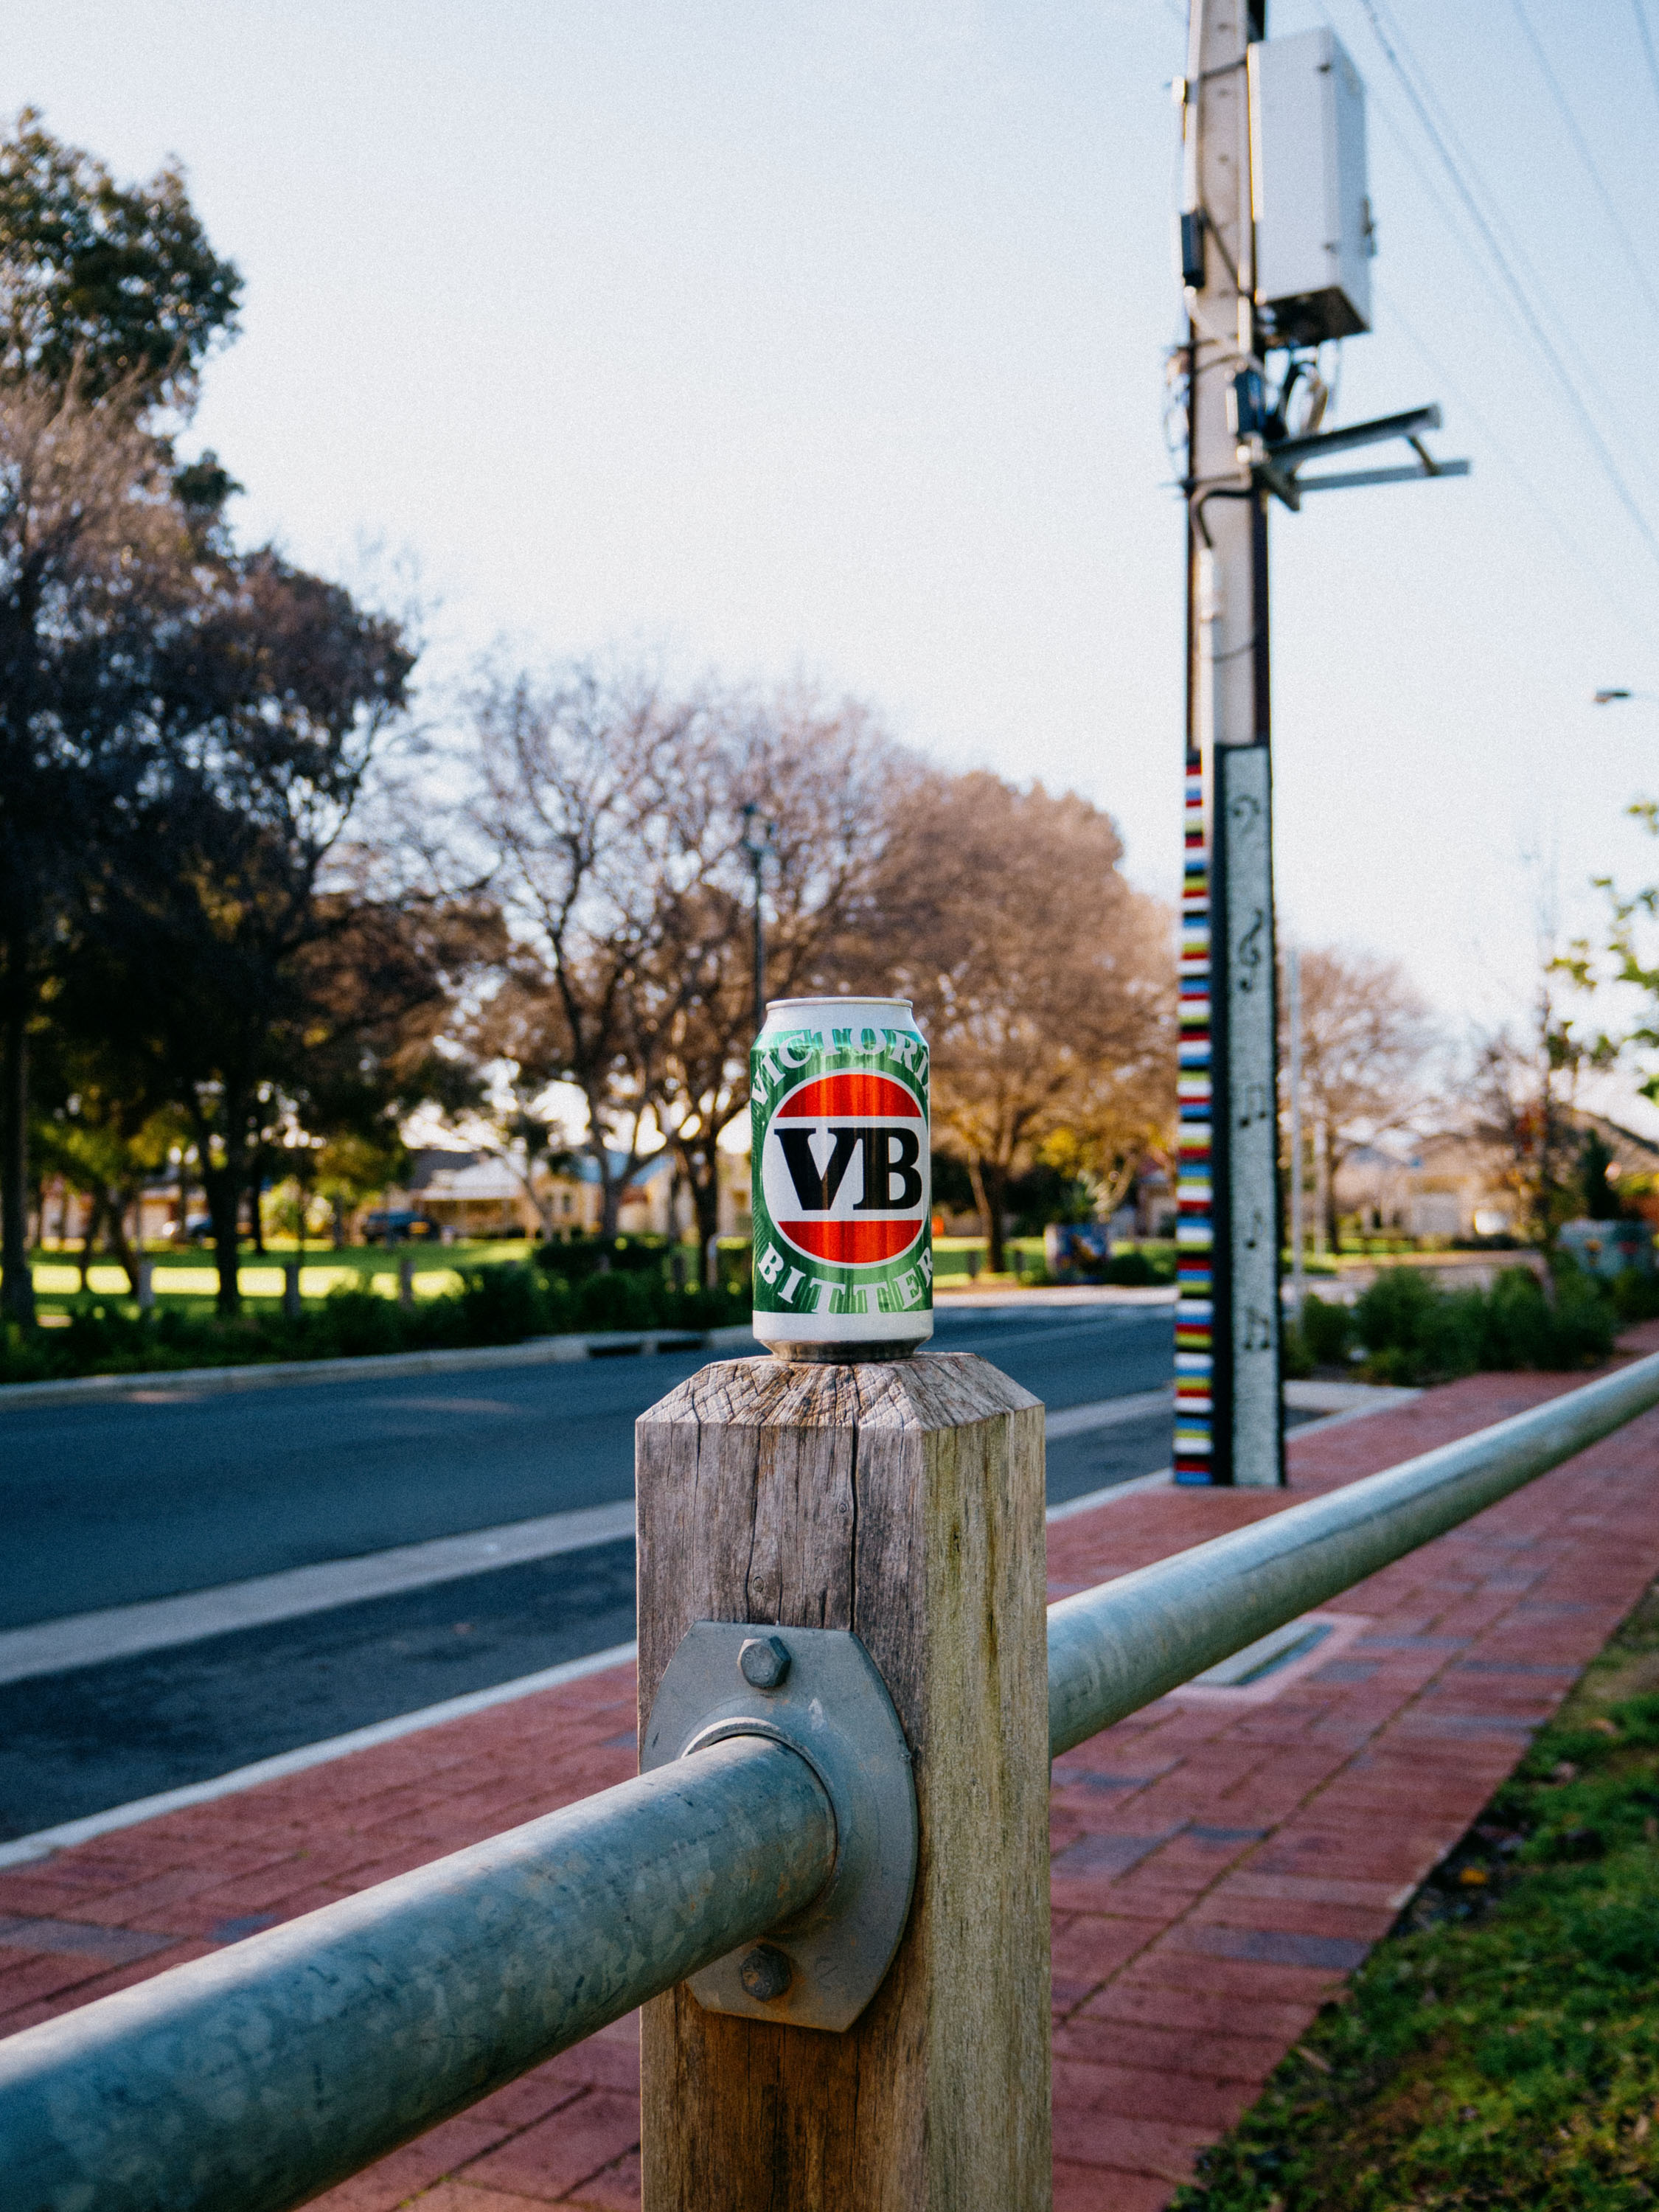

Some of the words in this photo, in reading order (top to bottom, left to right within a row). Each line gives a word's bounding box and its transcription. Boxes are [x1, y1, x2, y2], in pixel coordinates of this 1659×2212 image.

[751, 1029, 929, 1106] VICTORI
[773, 1127, 922, 1211] VB
[758, 1242, 933, 1314] BITTER
